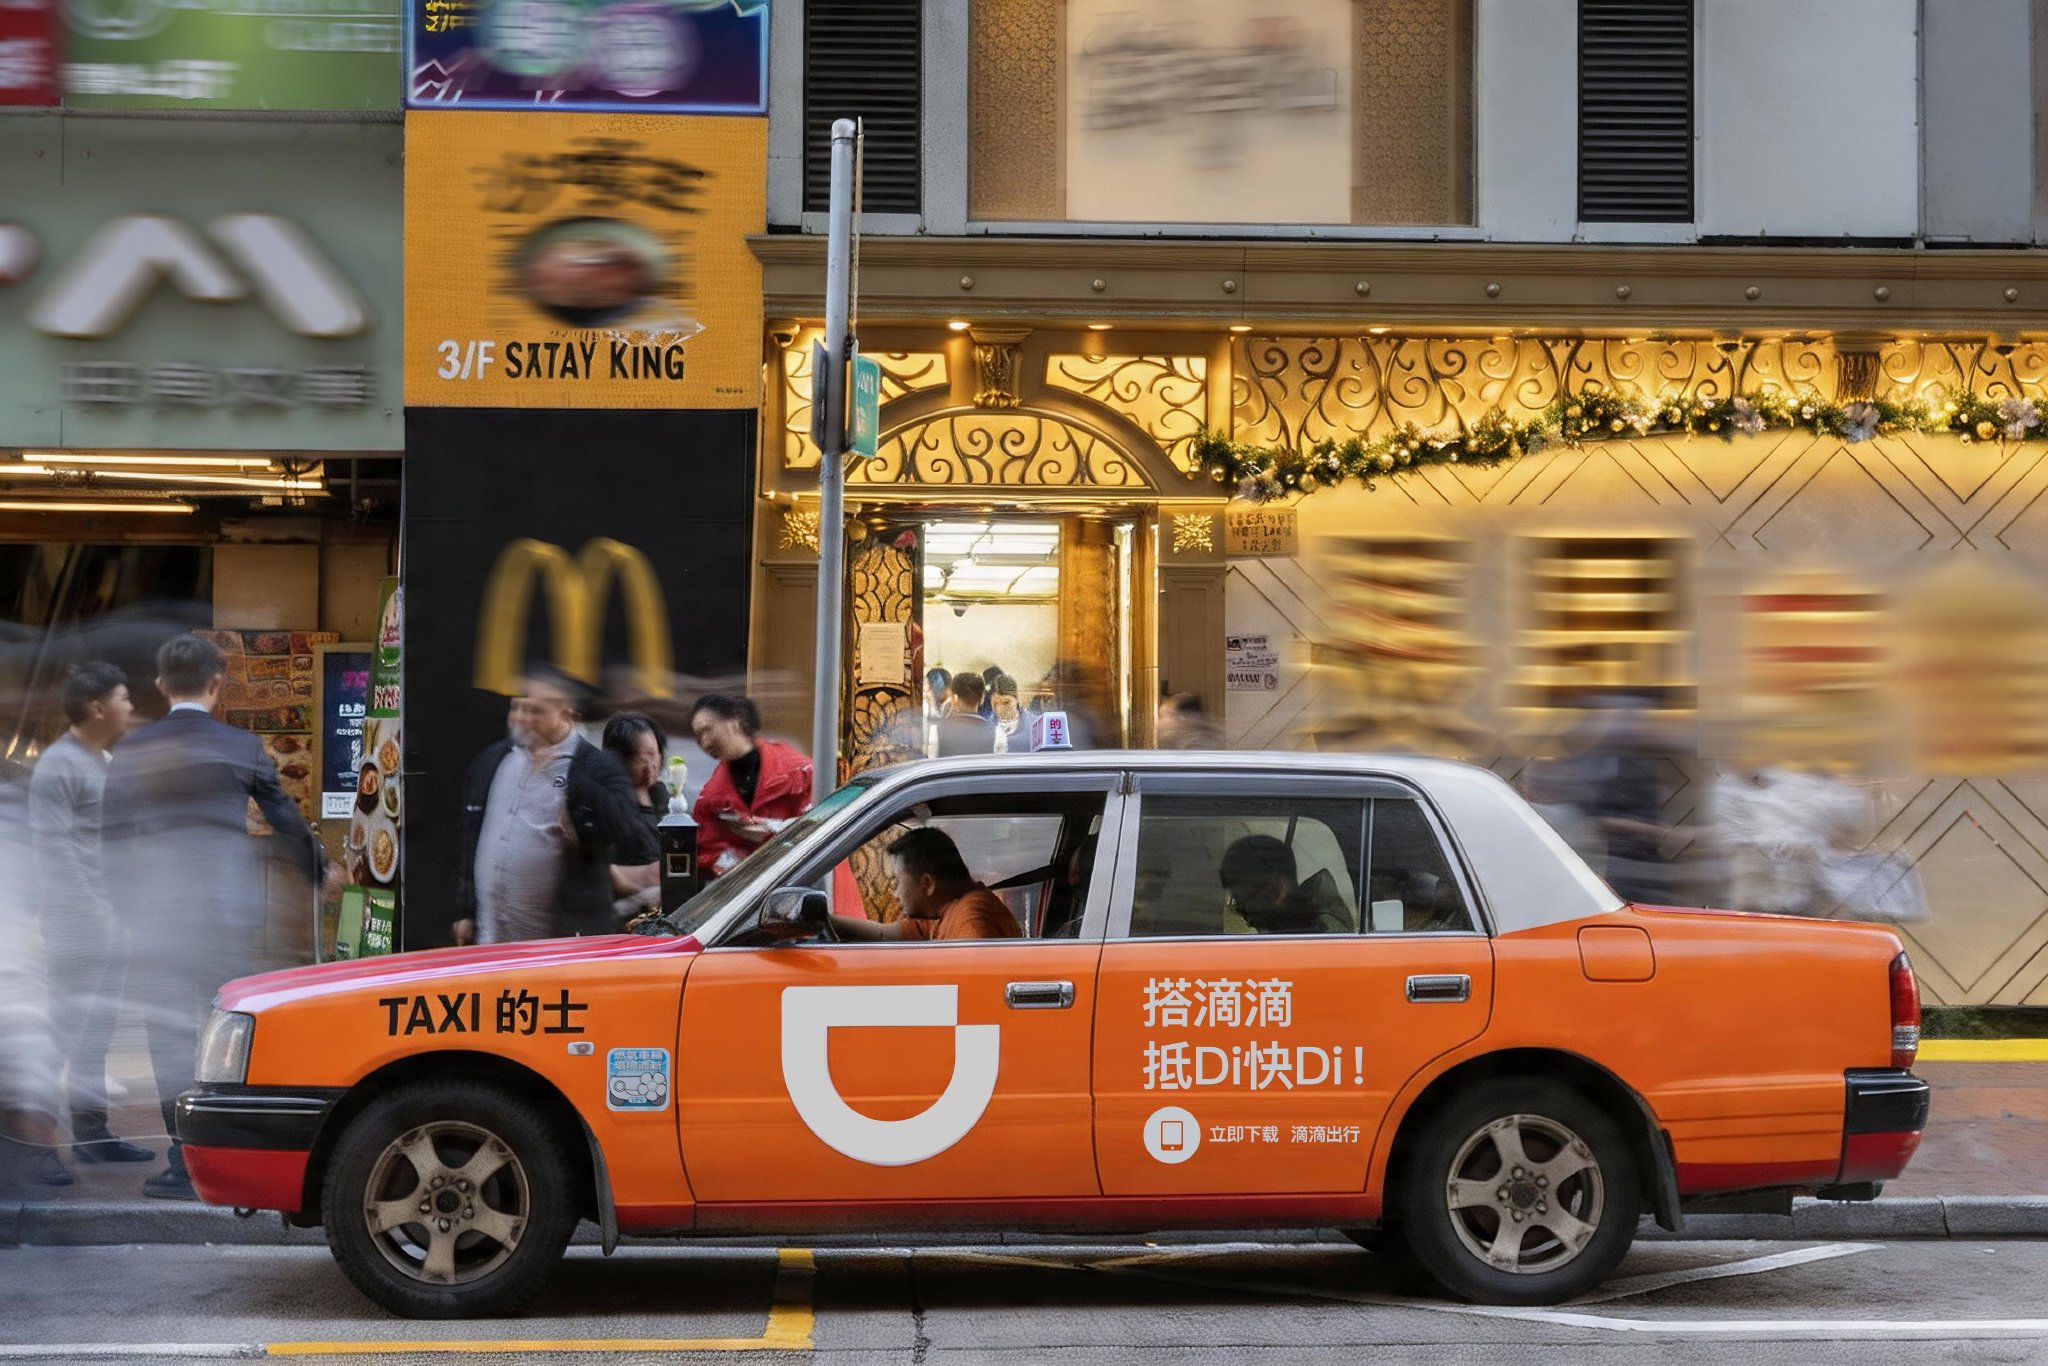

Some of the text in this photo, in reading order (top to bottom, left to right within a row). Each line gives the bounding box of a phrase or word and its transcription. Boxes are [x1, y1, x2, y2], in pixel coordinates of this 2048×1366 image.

[437, 340, 496, 380] 3/F
[609, 341, 684, 380] KING
[1049, 718, 1063, 743] 的士
[379, 988, 589, 1036] TAXI 的士
[1143, 977, 1293, 1028] 搭滴滴
[1209, 1125, 1360, 1143] 立即下载 滴滴出行
